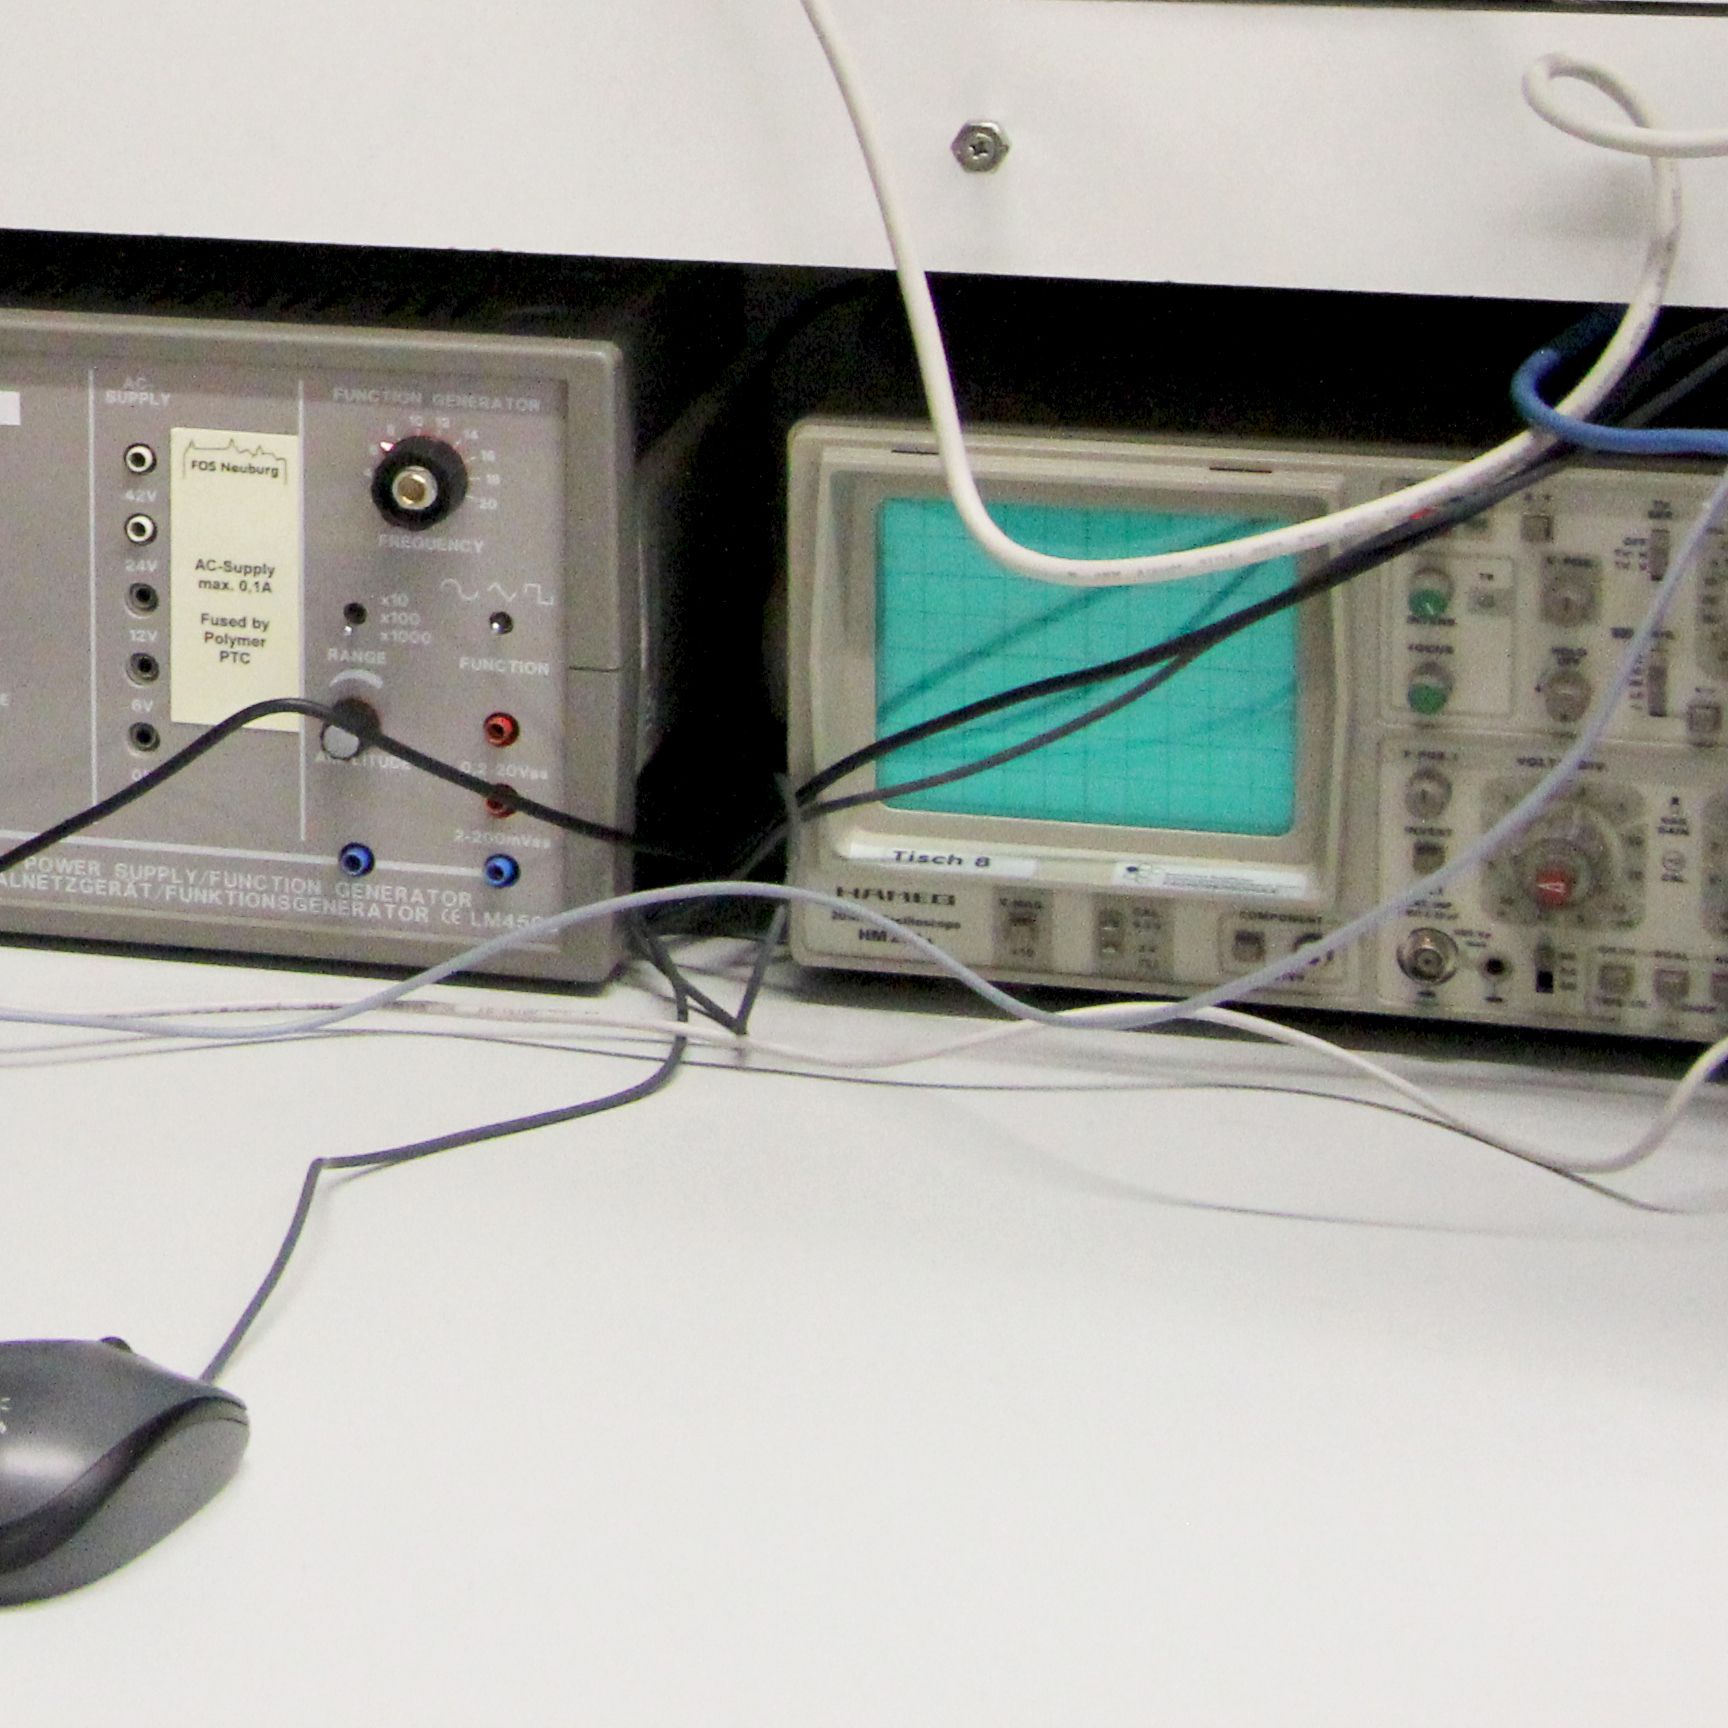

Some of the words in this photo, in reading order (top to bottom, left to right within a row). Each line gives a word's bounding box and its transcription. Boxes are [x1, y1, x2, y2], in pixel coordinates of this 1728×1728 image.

[105, 390, 170, 406] SUPPLY
[333, 387, 422, 404] FUNCTION
[433, 393, 540, 412] GENERATOR
[191, 459, 216, 472] FOS
[221, 461, 279, 478] Neuburg
[195, 558, 275, 577] AC-Supply
[198, 579, 234, 592] max.
[200, 613, 245, 628] Fused
[251, 617, 270, 632] by
[128, 630, 158, 643] 12V
[204, 632, 267, 649] Polymer
[219, 651, 251, 664] PTC
[328, 648, 386, 664] RANGE
[459, 657, 550, 677] FUNCTION
[894, 850, 963, 866] Tisch
[974, 856, 991, 868] 8
[24, 855, 101, 876] POWER
[114, 862, 322, 897] SUPPLY/FUNCTION
[334, 881, 472, 908] GENERATOR
